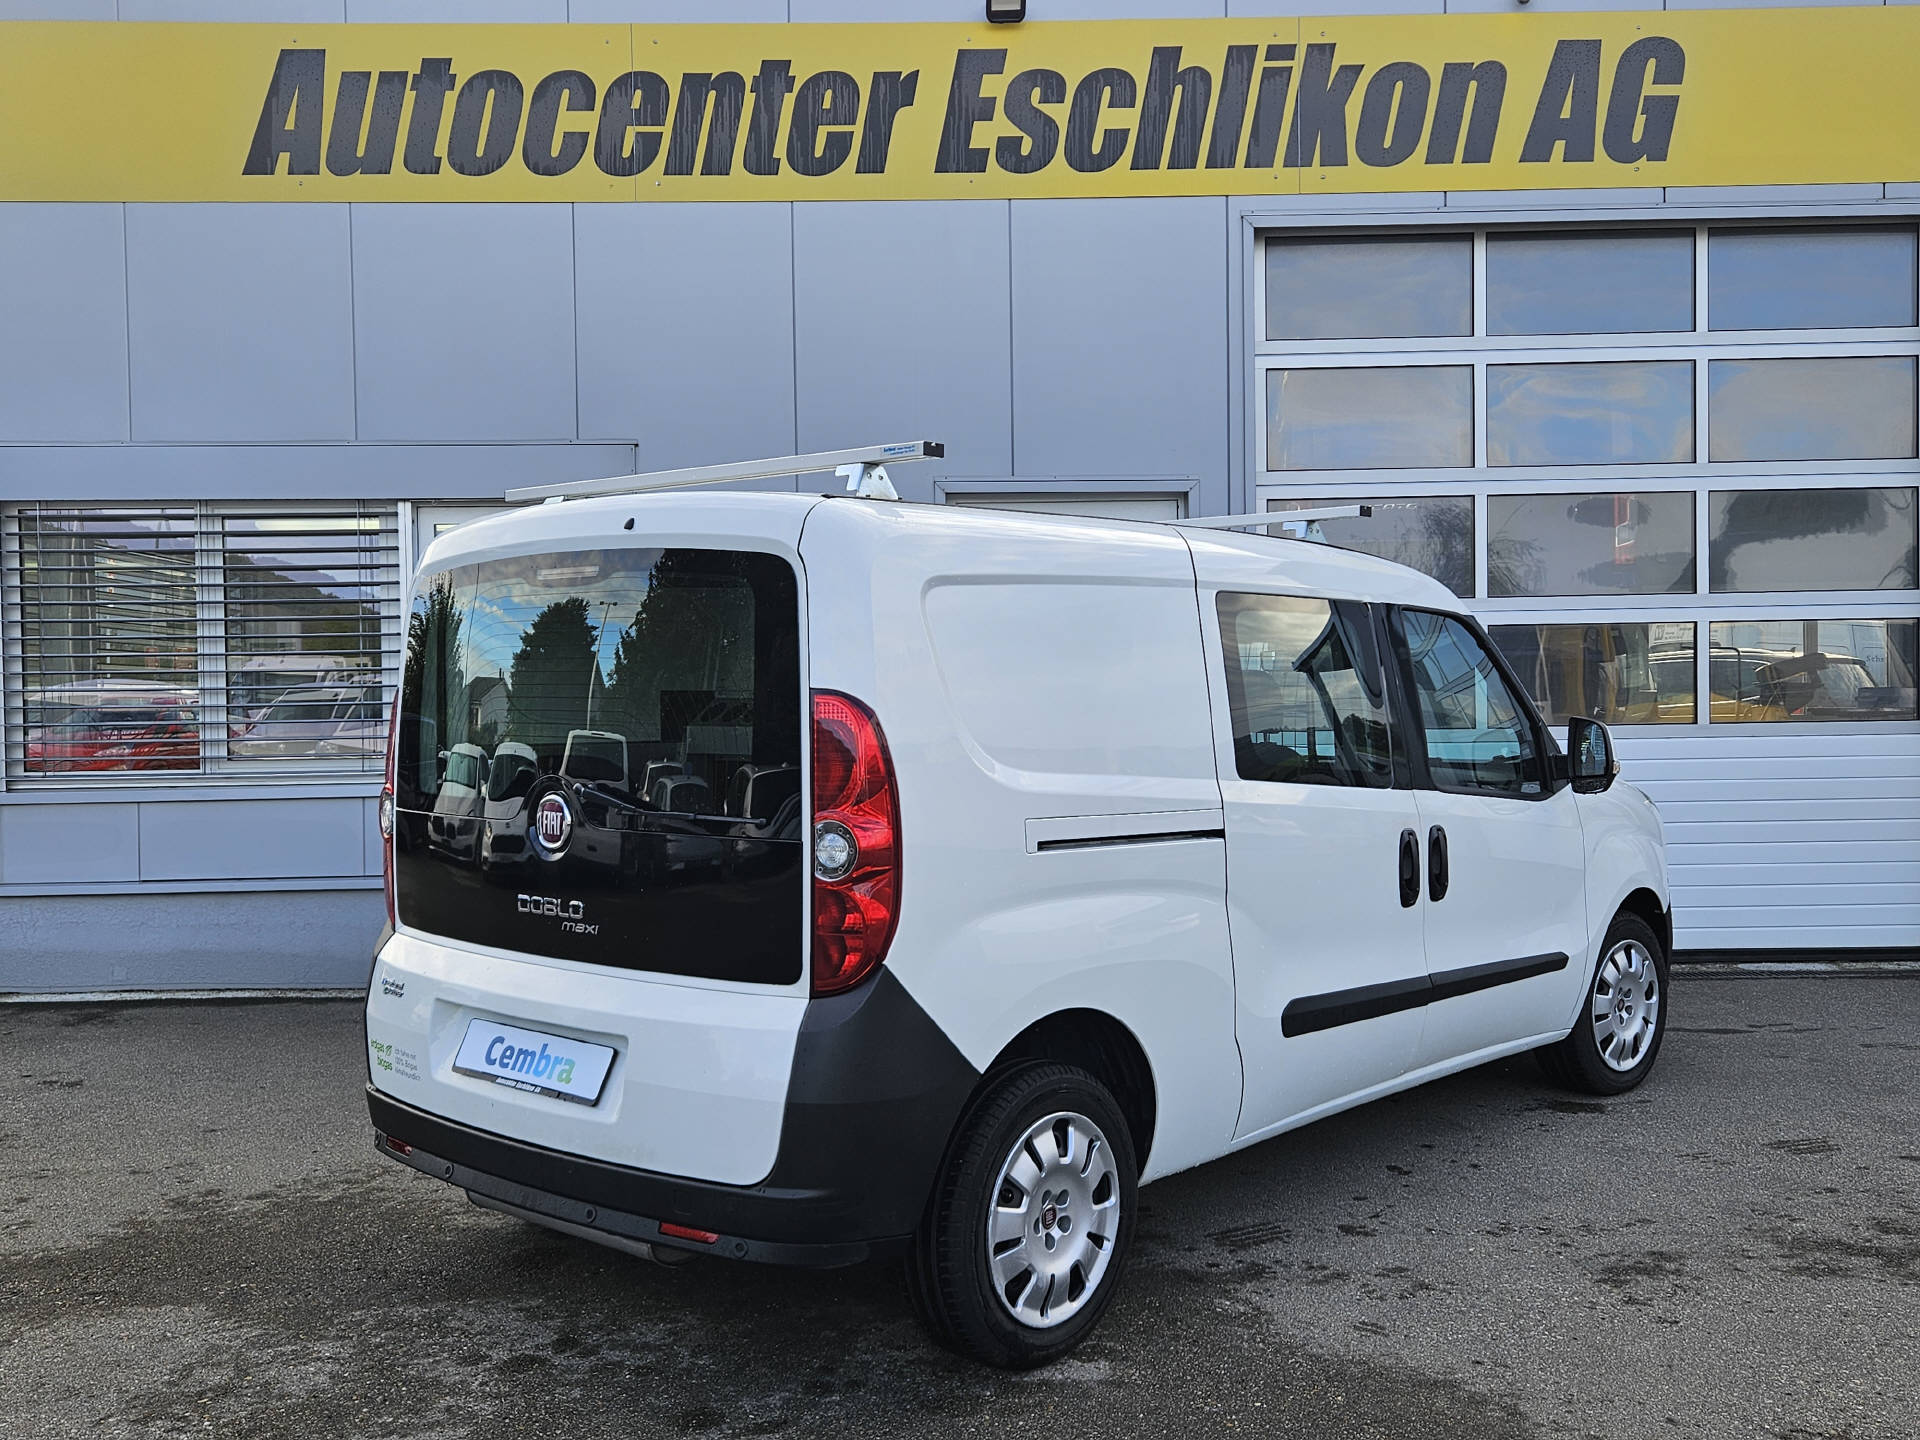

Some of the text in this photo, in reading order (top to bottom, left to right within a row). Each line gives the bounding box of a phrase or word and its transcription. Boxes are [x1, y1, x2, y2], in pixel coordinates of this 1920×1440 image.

[242, 36, 1687, 176] Autocenter Eschlikon AG
[542, 810, 563, 836] FIAT
[517, 893, 584, 919] DOBLO
[561, 921, 600, 935] maxi
[484, 1035, 576, 1085] Cembra
